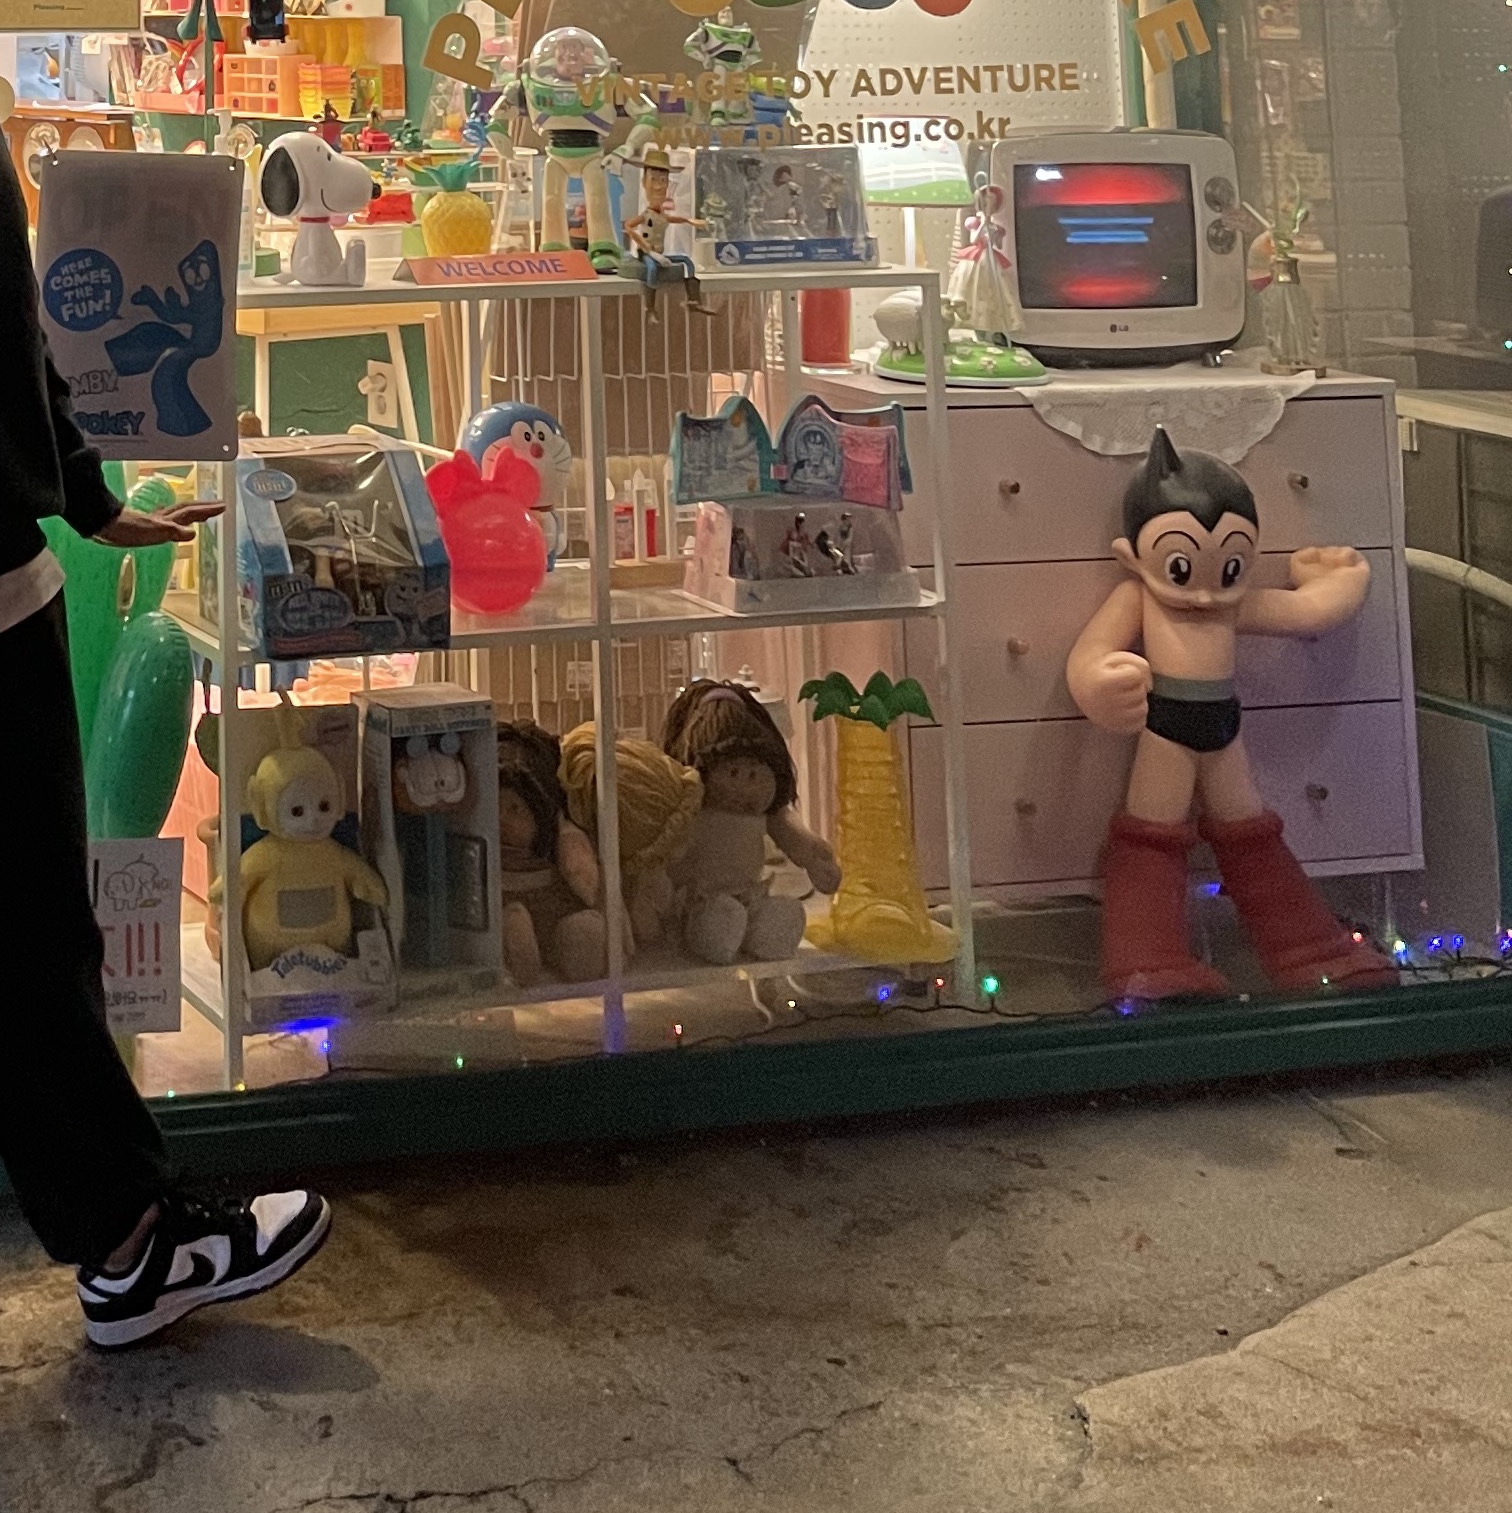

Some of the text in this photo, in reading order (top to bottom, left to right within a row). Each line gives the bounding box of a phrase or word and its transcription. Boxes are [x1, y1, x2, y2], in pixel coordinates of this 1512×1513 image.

[574, 61, 1081, 109] VINTAGE TOY ADVENTURE
[654, 109, 1012, 152] www.pleasing.co.kr
[50, 269, 113, 290] COMES
[436, 258, 568, 278] WELCOME
[61, 289, 113, 323] FUN!
[63, 285, 95, 302] THE
